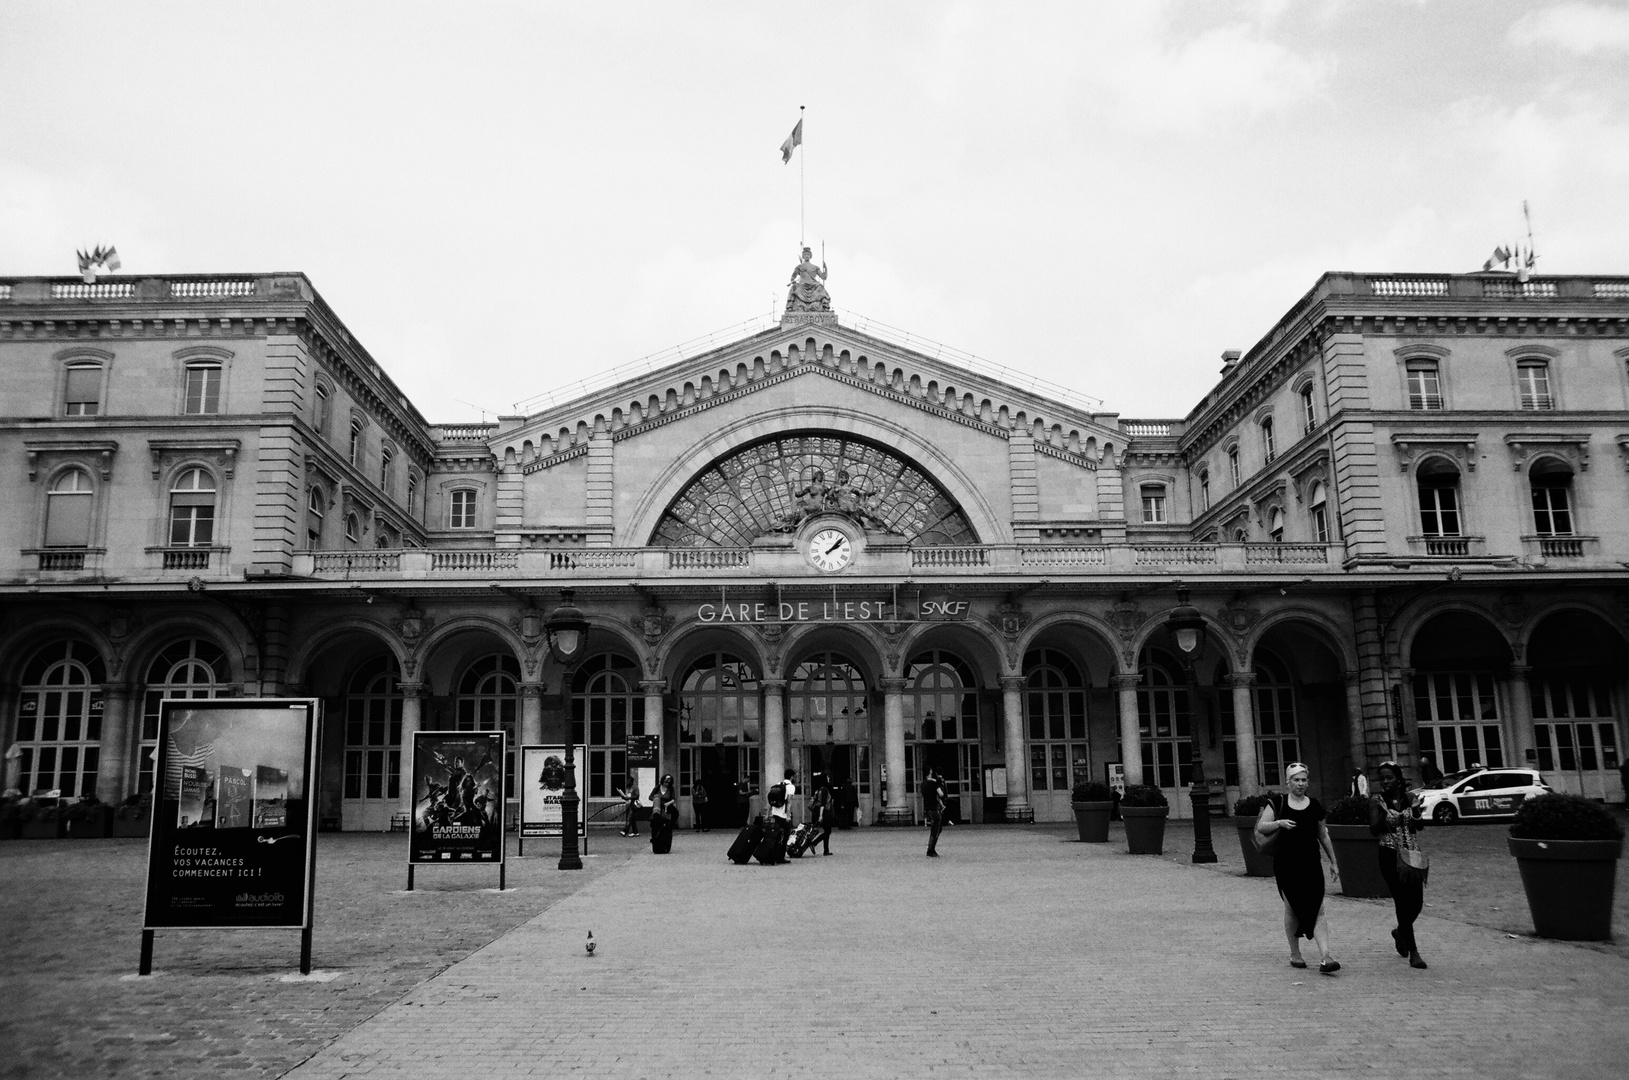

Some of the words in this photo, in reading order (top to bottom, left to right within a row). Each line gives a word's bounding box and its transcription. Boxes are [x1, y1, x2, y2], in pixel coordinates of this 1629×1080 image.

[698, 603, 765, 622] GARE
[780, 602, 809, 621] DE
[823, 601, 886, 620] L'EST
[920, 601, 969, 615] SNCF
[1474, 798, 1491, 810] RTL
[432, 825, 482, 834] GARDIENS
[174, 844, 222, 856] ÉCOUTEZ,
[173, 858, 191, 866] VOS
[195, 858, 244, 866] VACANCES
[172, 869, 234, 877] COMMENCENT
[238, 869, 254, 877] ICI
